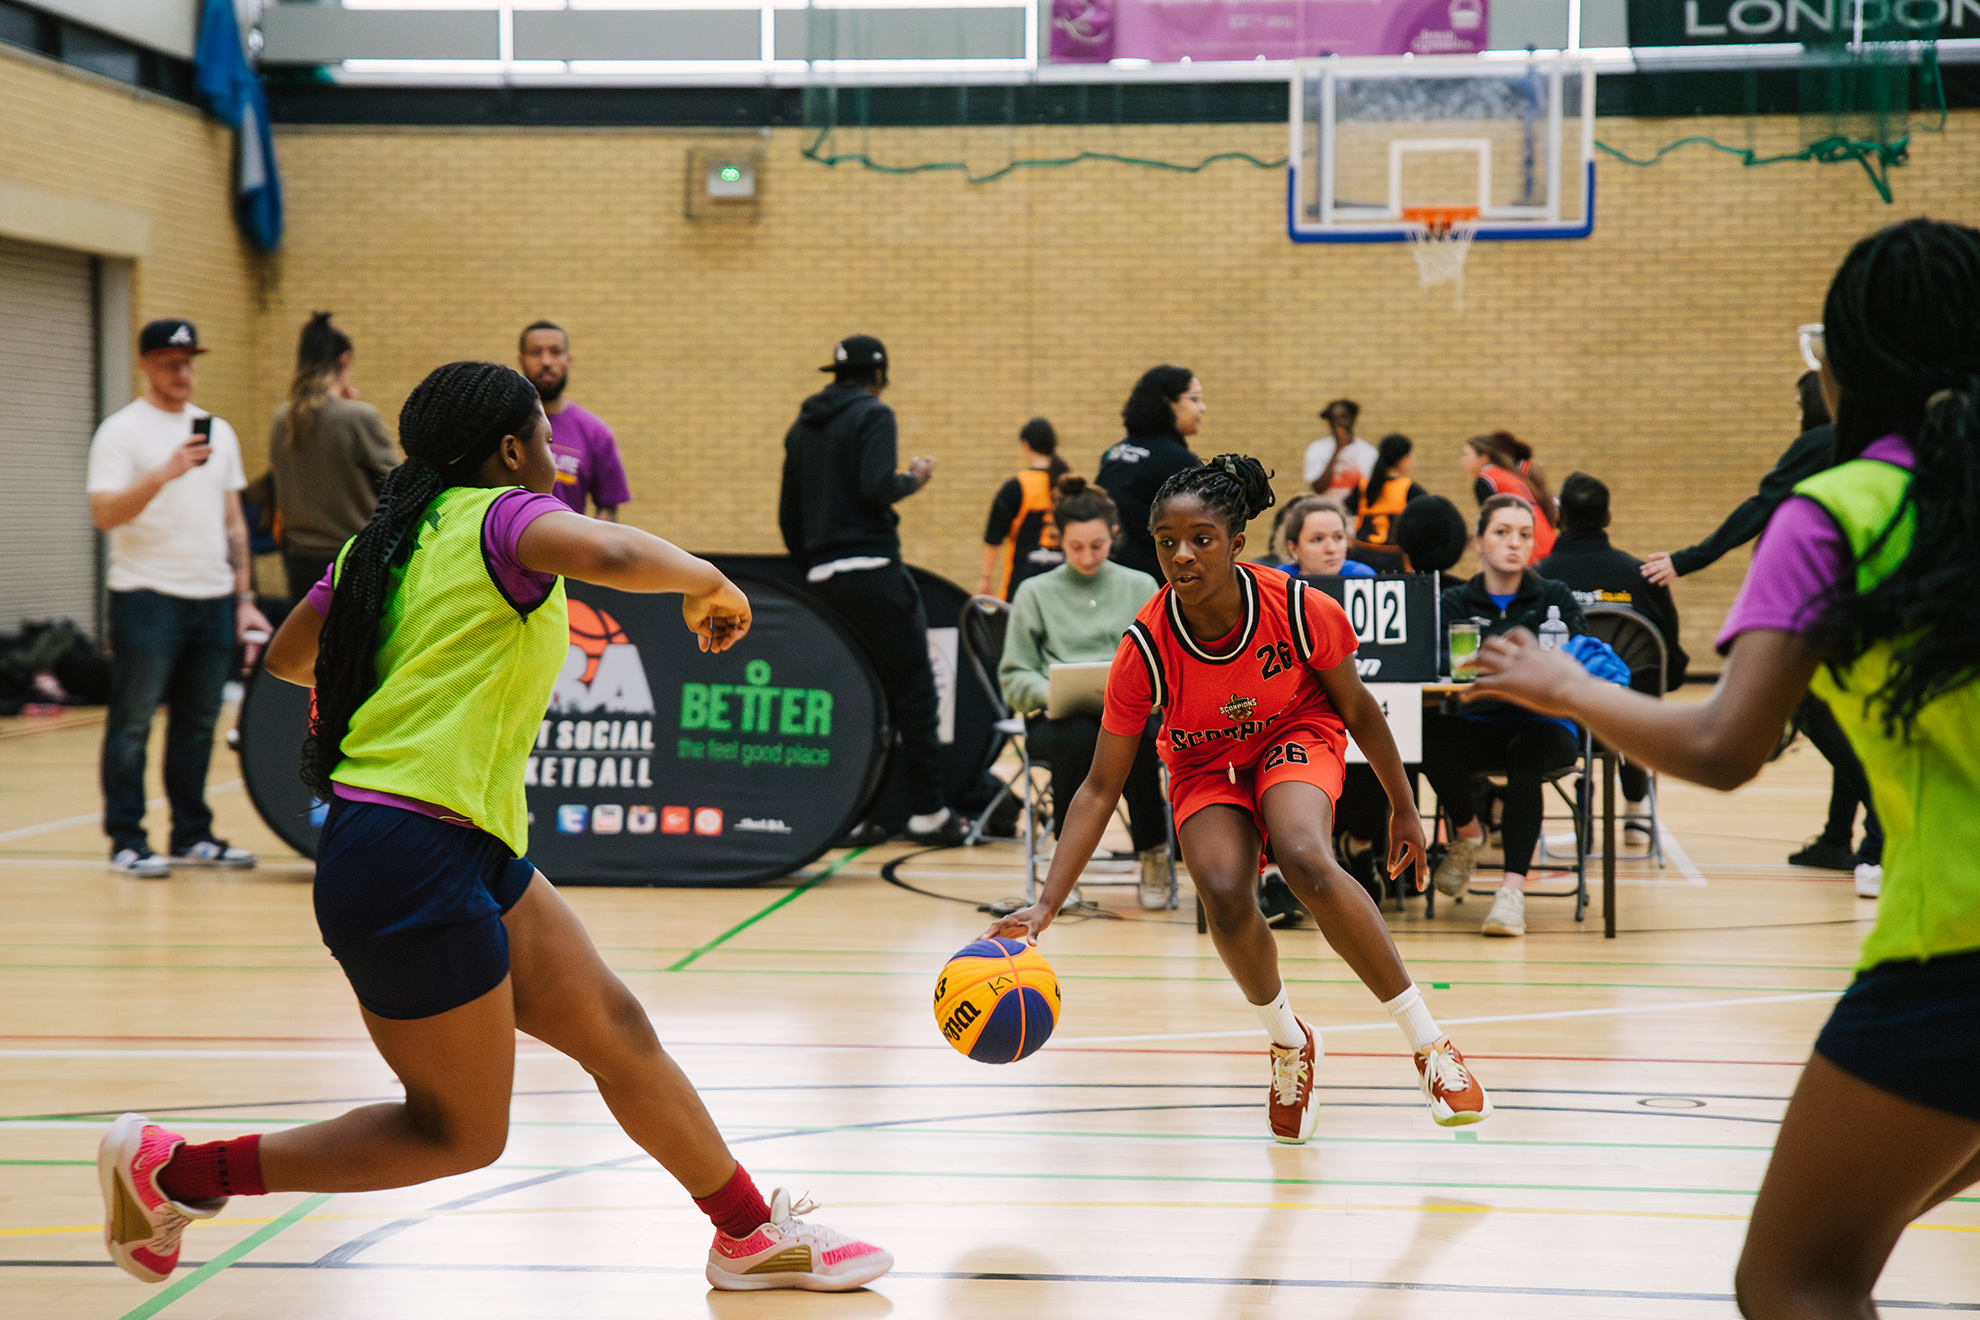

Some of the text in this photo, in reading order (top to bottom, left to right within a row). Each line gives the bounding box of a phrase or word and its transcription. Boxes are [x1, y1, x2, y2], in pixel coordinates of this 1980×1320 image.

[1256, 640, 1293, 681] 26
[680, 682, 833, 736] BETTER
[556, 720, 655, 750] SOCIAL
[525, 757, 653, 788] KETBALL
[1264, 741, 1309, 773] 26
